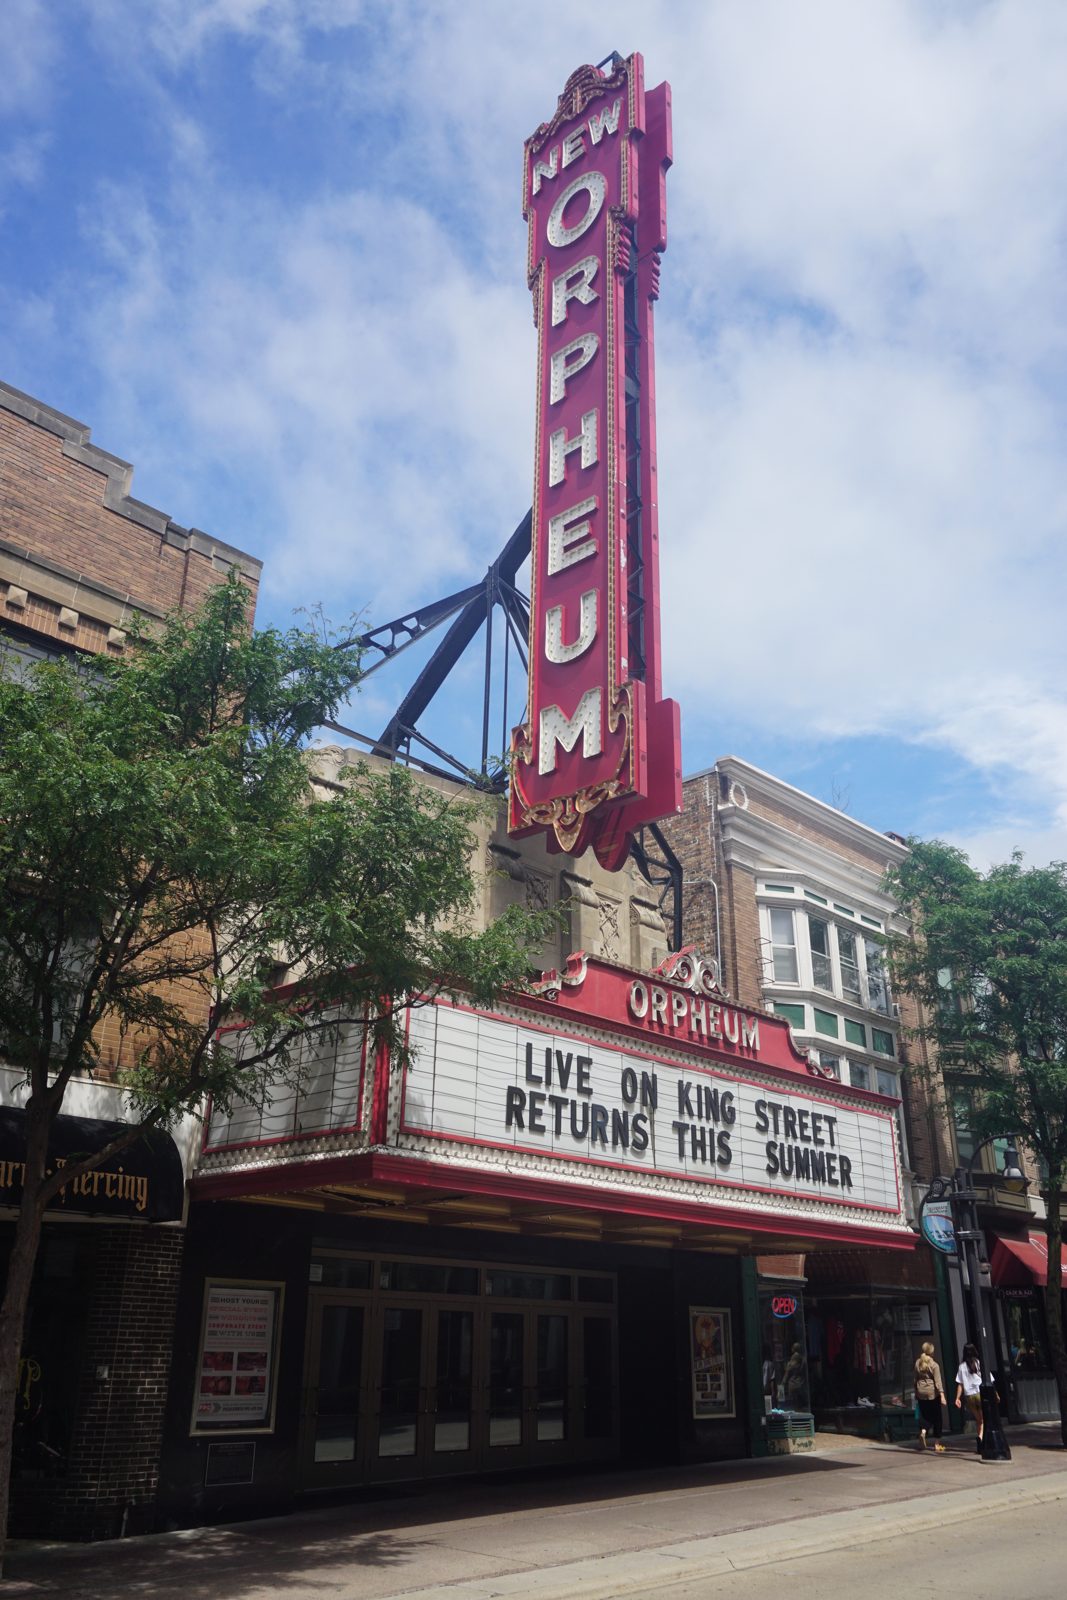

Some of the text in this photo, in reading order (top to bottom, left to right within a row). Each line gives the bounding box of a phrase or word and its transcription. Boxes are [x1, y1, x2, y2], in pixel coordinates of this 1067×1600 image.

[532, 97, 625, 196] NEW
[538, 171, 608, 776] ORPHEUM
[629, 979, 761, 1051] ORPHEUM
[505, 1085, 853, 1188] RETURNS THIS SUMMER
[525, 1042, 838, 1147] LIVE ON KING STREET
[771, 1296, 795, 1314] OPEN
